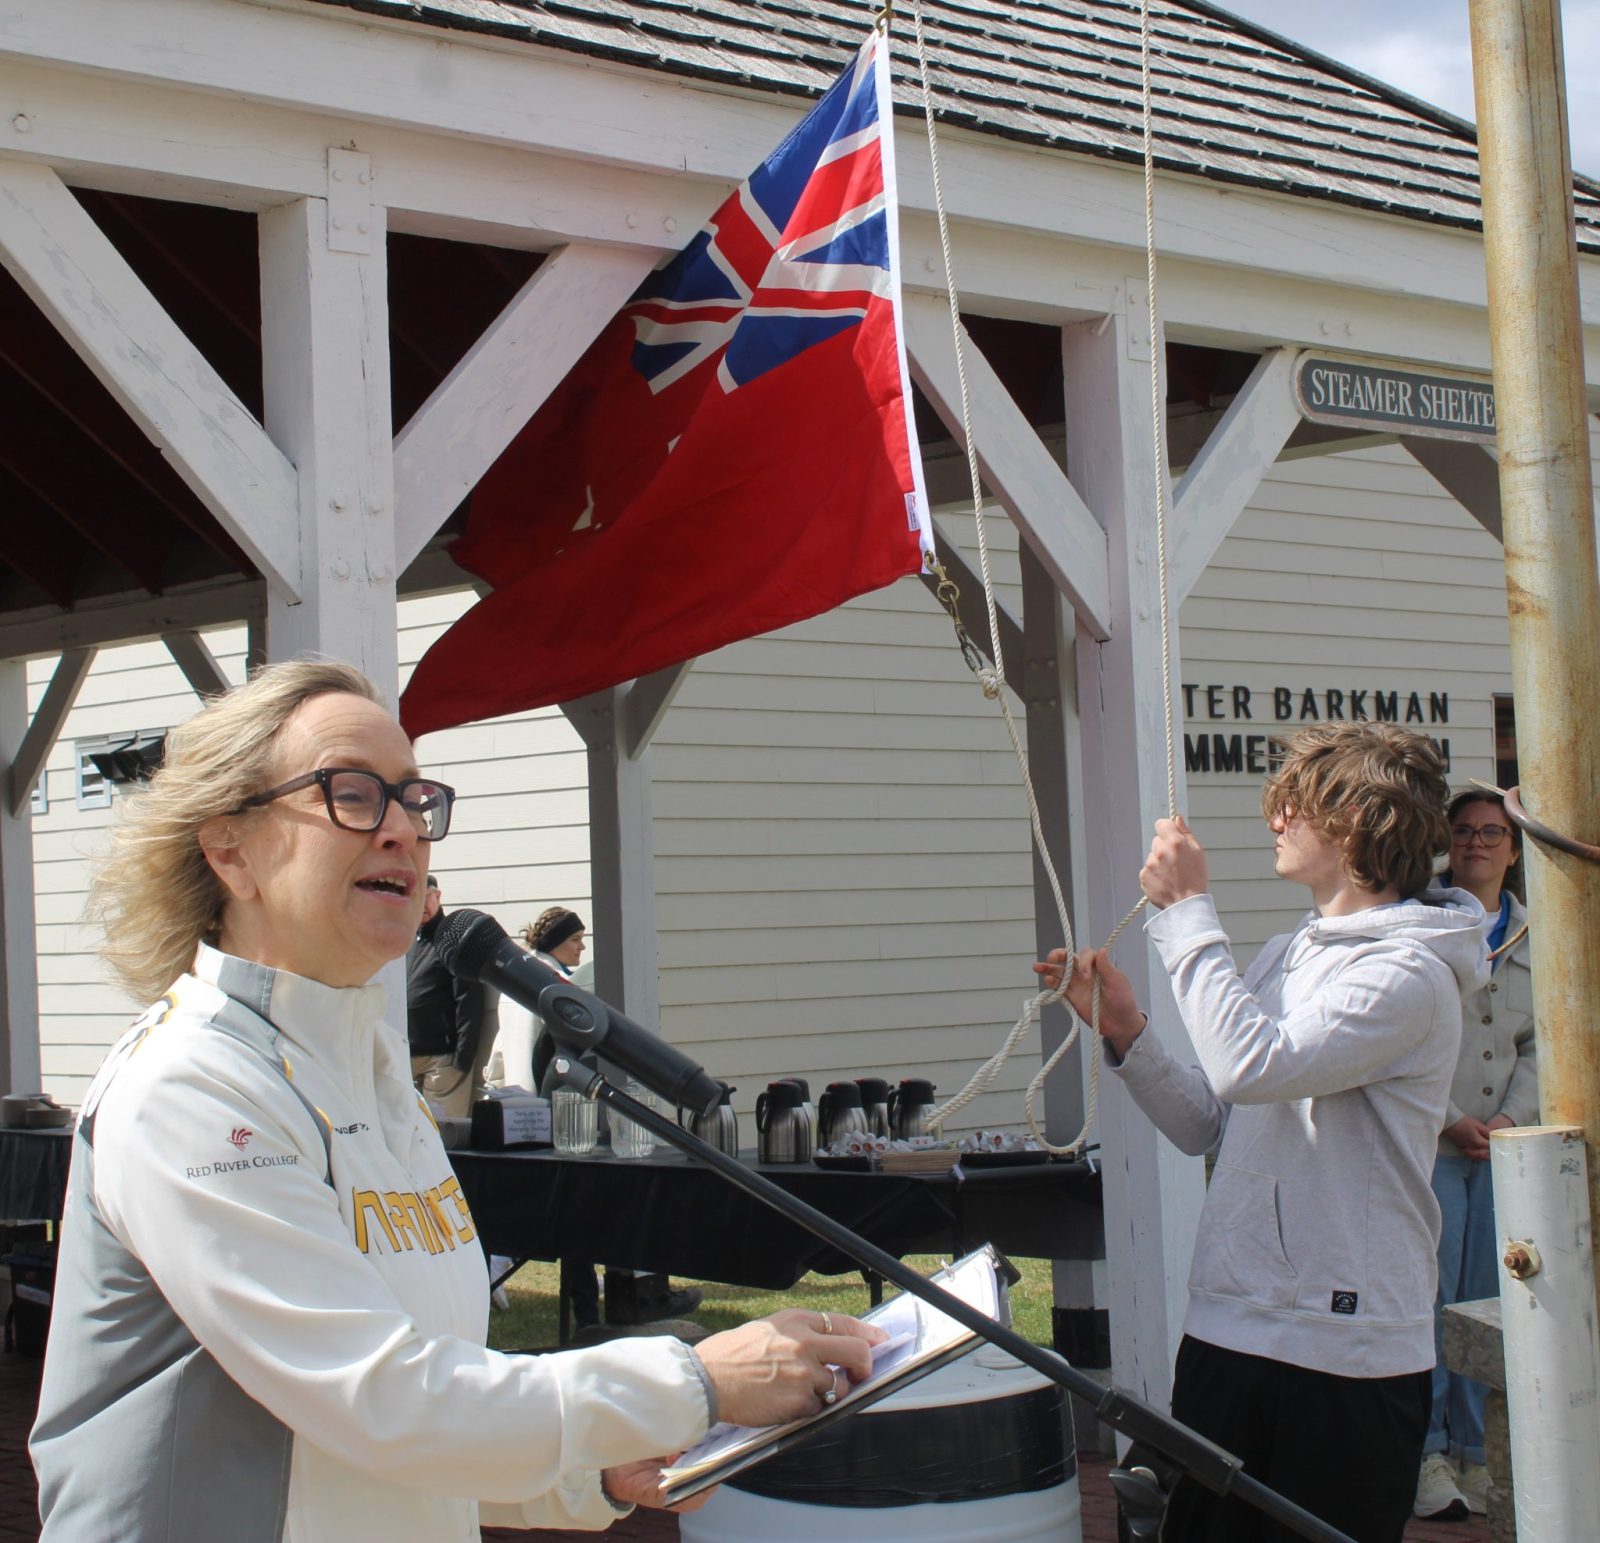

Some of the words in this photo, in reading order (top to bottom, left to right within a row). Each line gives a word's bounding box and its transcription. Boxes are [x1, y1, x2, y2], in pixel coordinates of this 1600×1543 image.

[1311, 368, 1414, 417] STEAMER
[1274, 686, 1449, 723] BARKMAN
[186, 1165, 211, 1179] RED
[213, 1159, 252, 1174] RIVER
